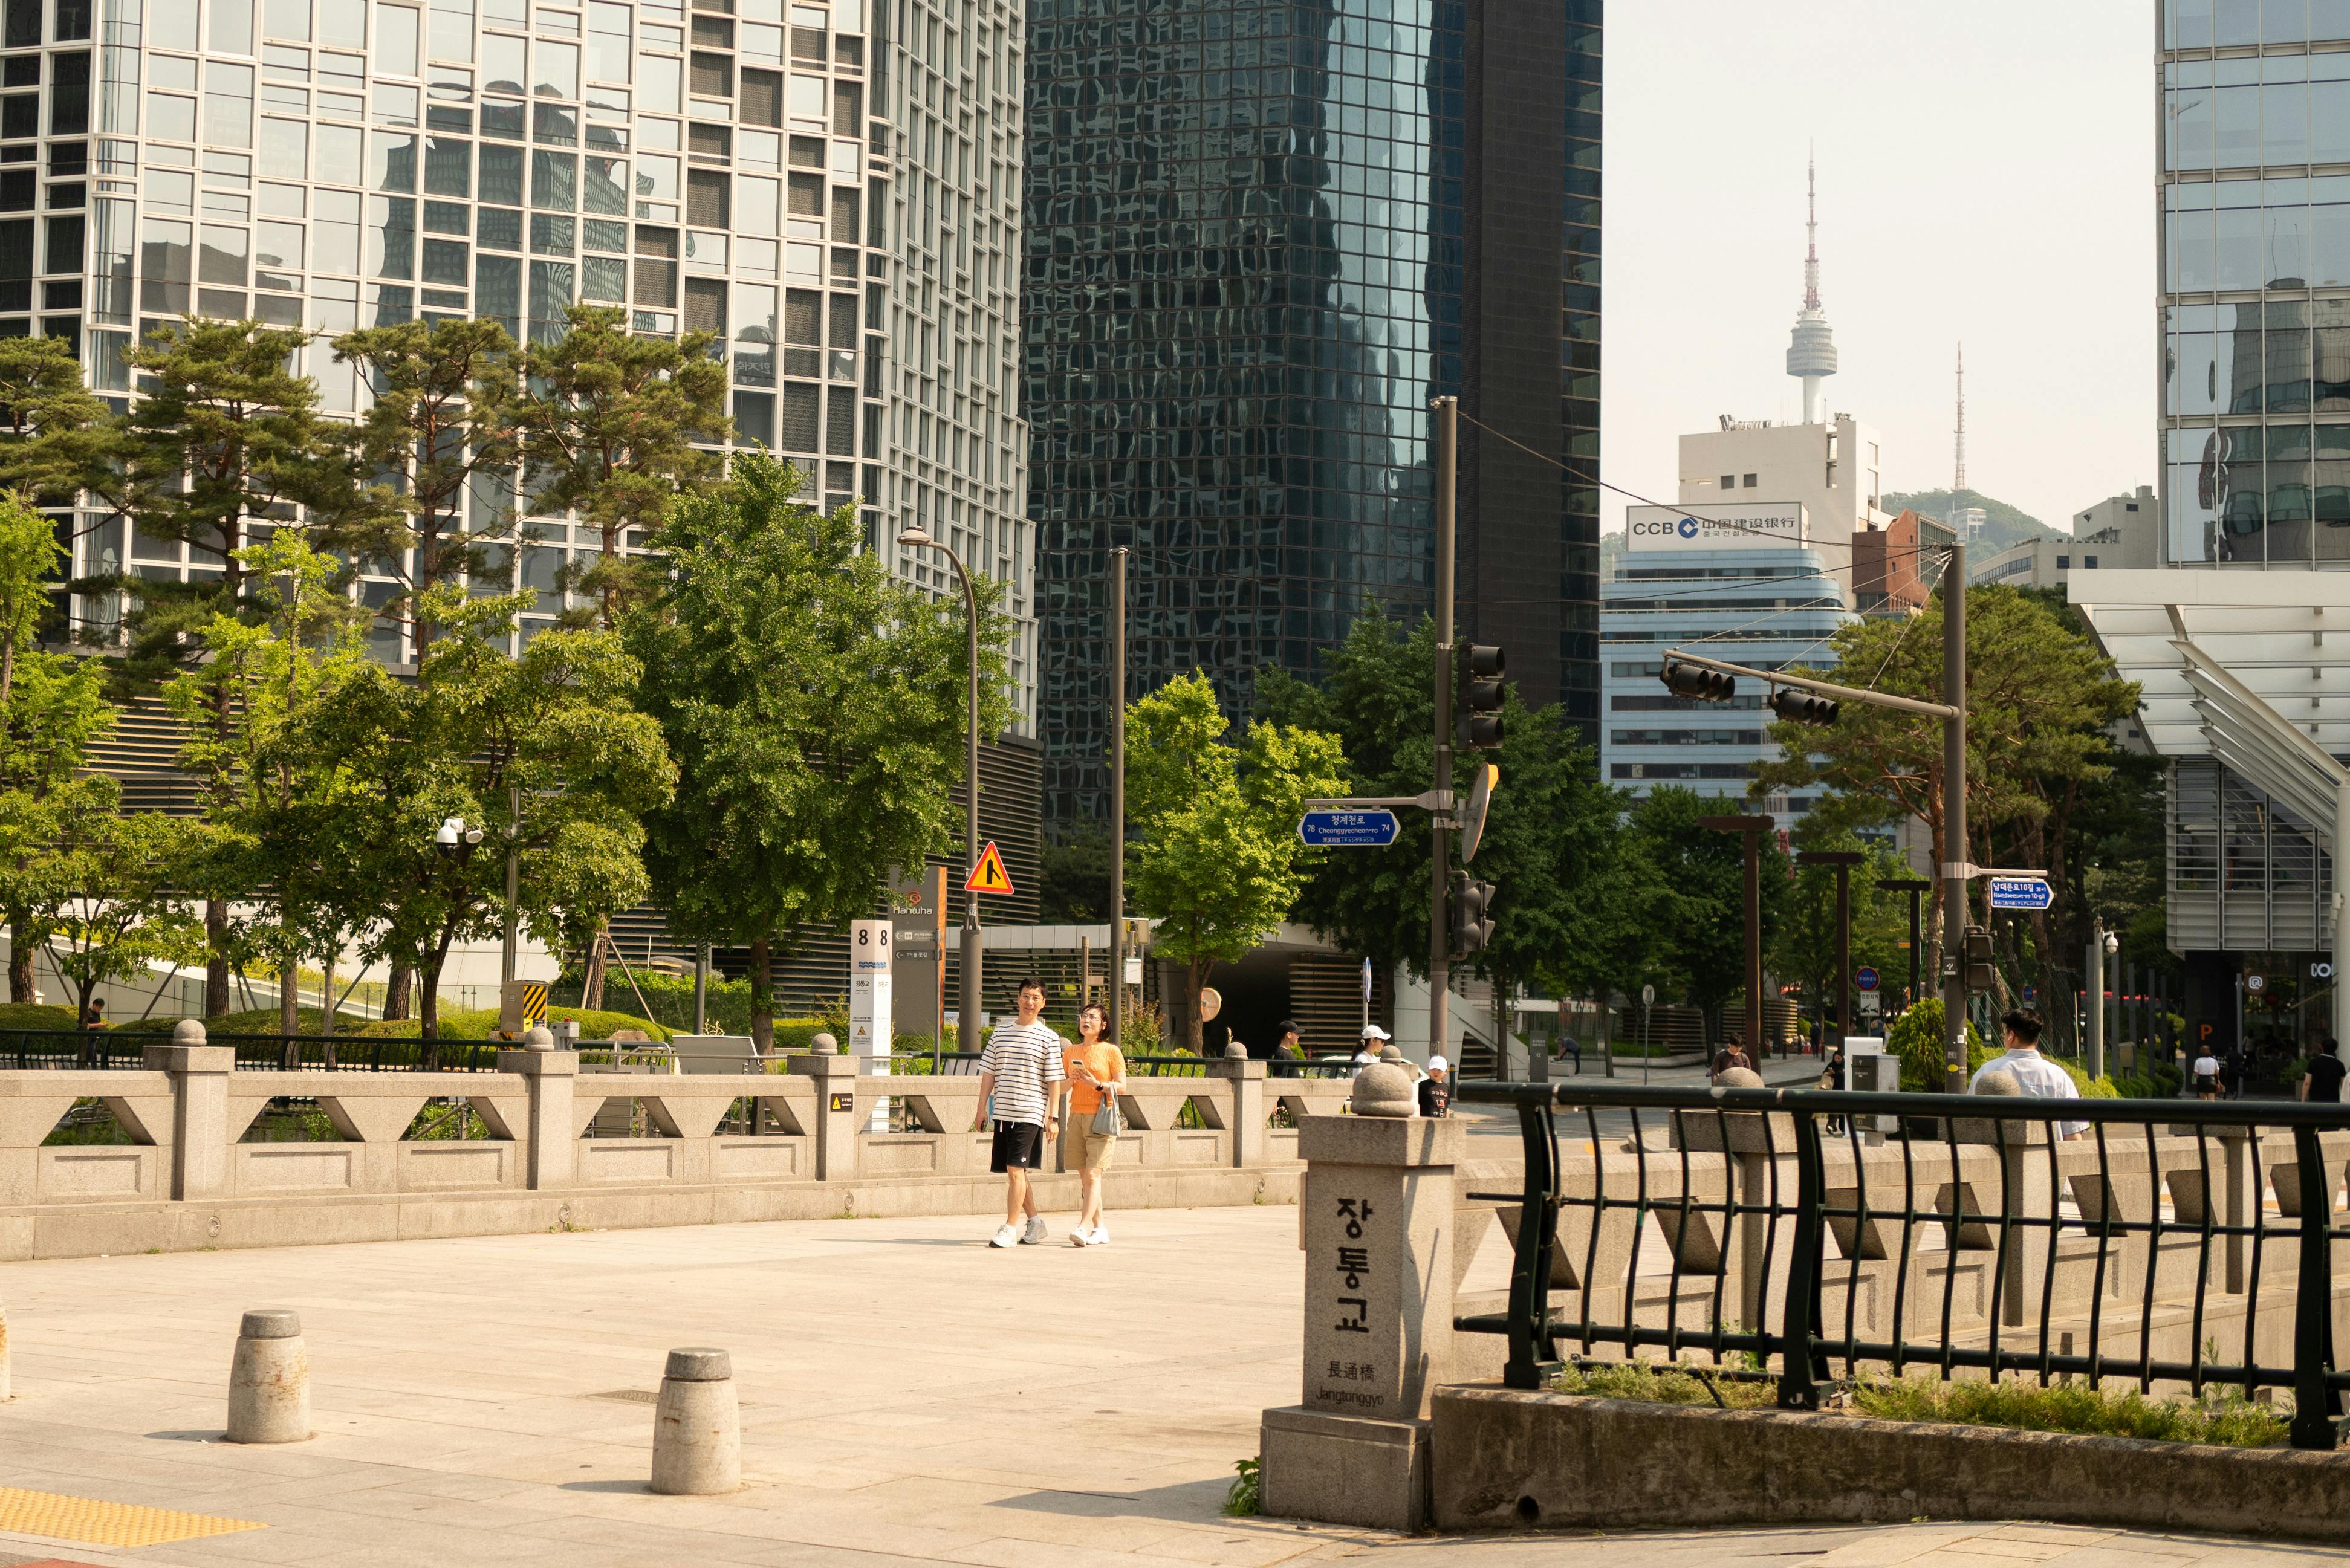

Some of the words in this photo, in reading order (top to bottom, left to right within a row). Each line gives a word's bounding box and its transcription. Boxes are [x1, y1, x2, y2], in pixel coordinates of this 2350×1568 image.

[1633, 522, 1674, 535] CCB
[1702, 517, 1795, 530] 中国建设银行
[1332, 815, 1365, 825] 청계천로
[1993, 883, 2033, 892] 남대문로10길
[894, 906, 932, 915] Hanwha
[859, 929, 868, 945] 8
[880, 930, 887, 945] 8
[2201, 1024, 2213, 1040] P
[1335, 1198, 1375, 1333] 장통교
[1327, 1361, 1375, 1382] 長通橋
[1316, 1386, 1384, 1408] Jangtonggyo
